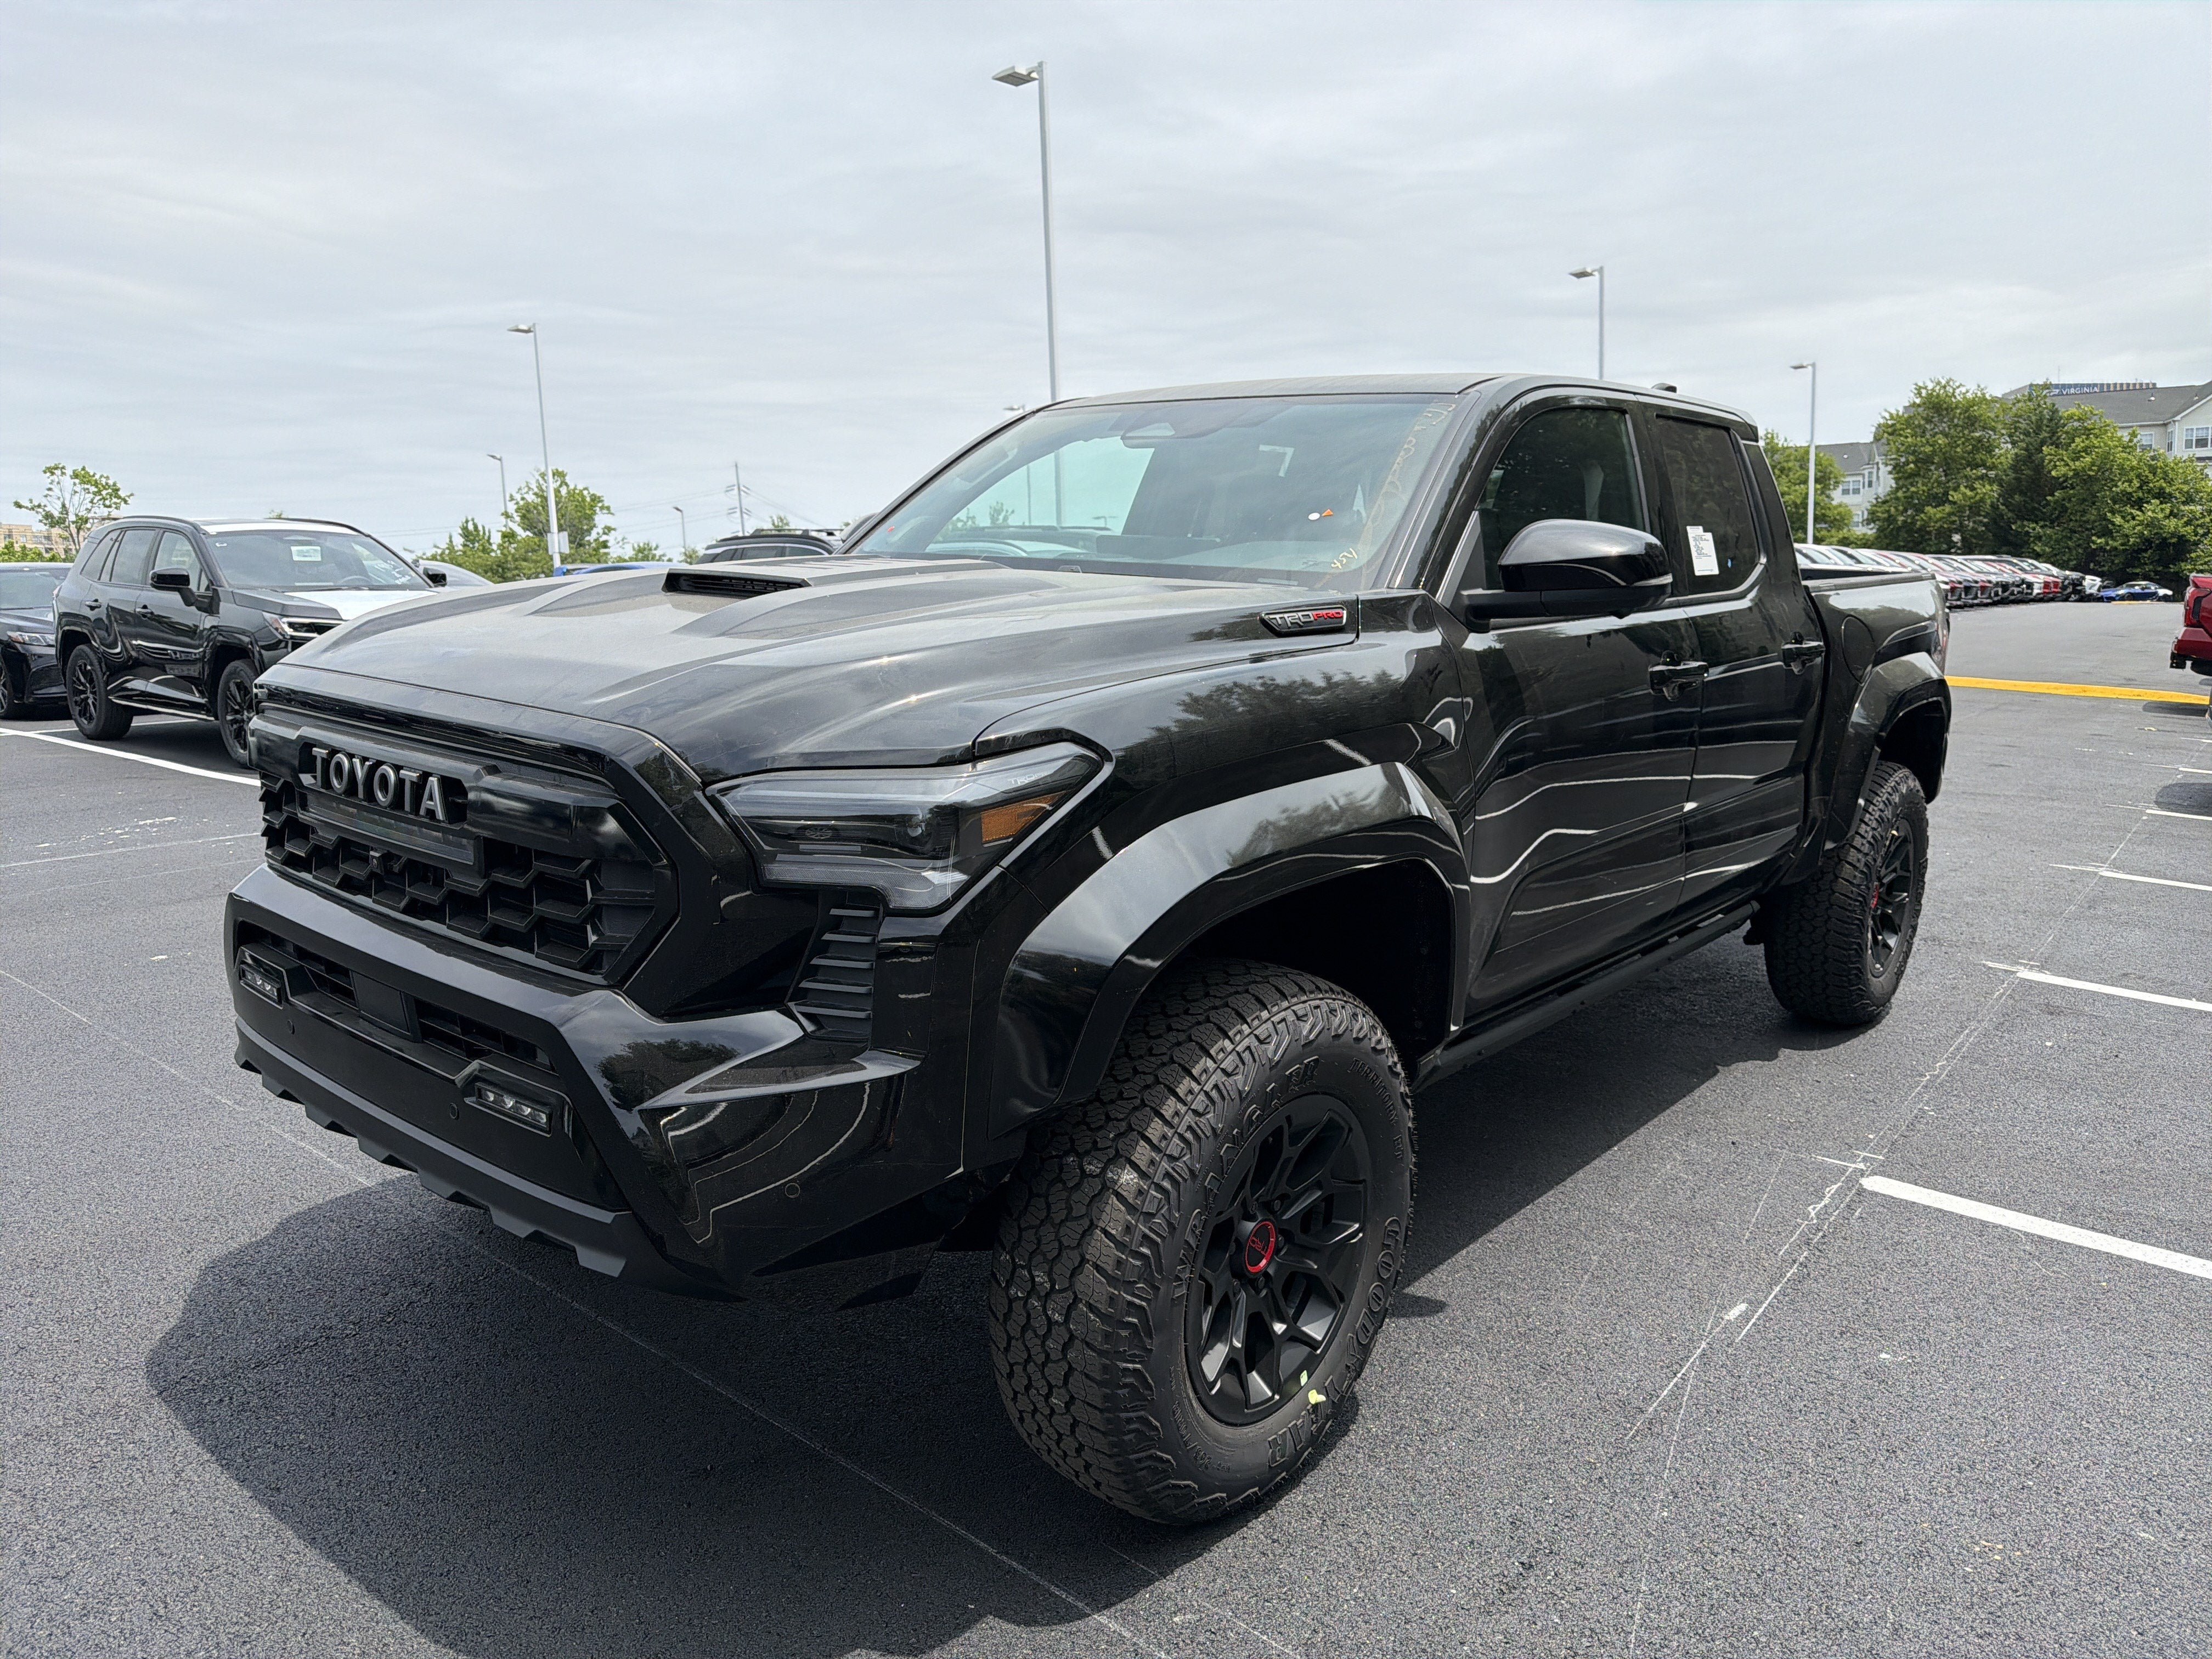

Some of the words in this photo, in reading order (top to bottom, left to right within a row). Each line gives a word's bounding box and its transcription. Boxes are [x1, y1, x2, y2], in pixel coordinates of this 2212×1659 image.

[2061, 386, 2098, 395] VIRGINIA
[312, 747, 447, 821] TOYOTA
[1347, 1057, 1398, 1125] TERRITORY
[1249, 1237, 1268, 1256] TRD
